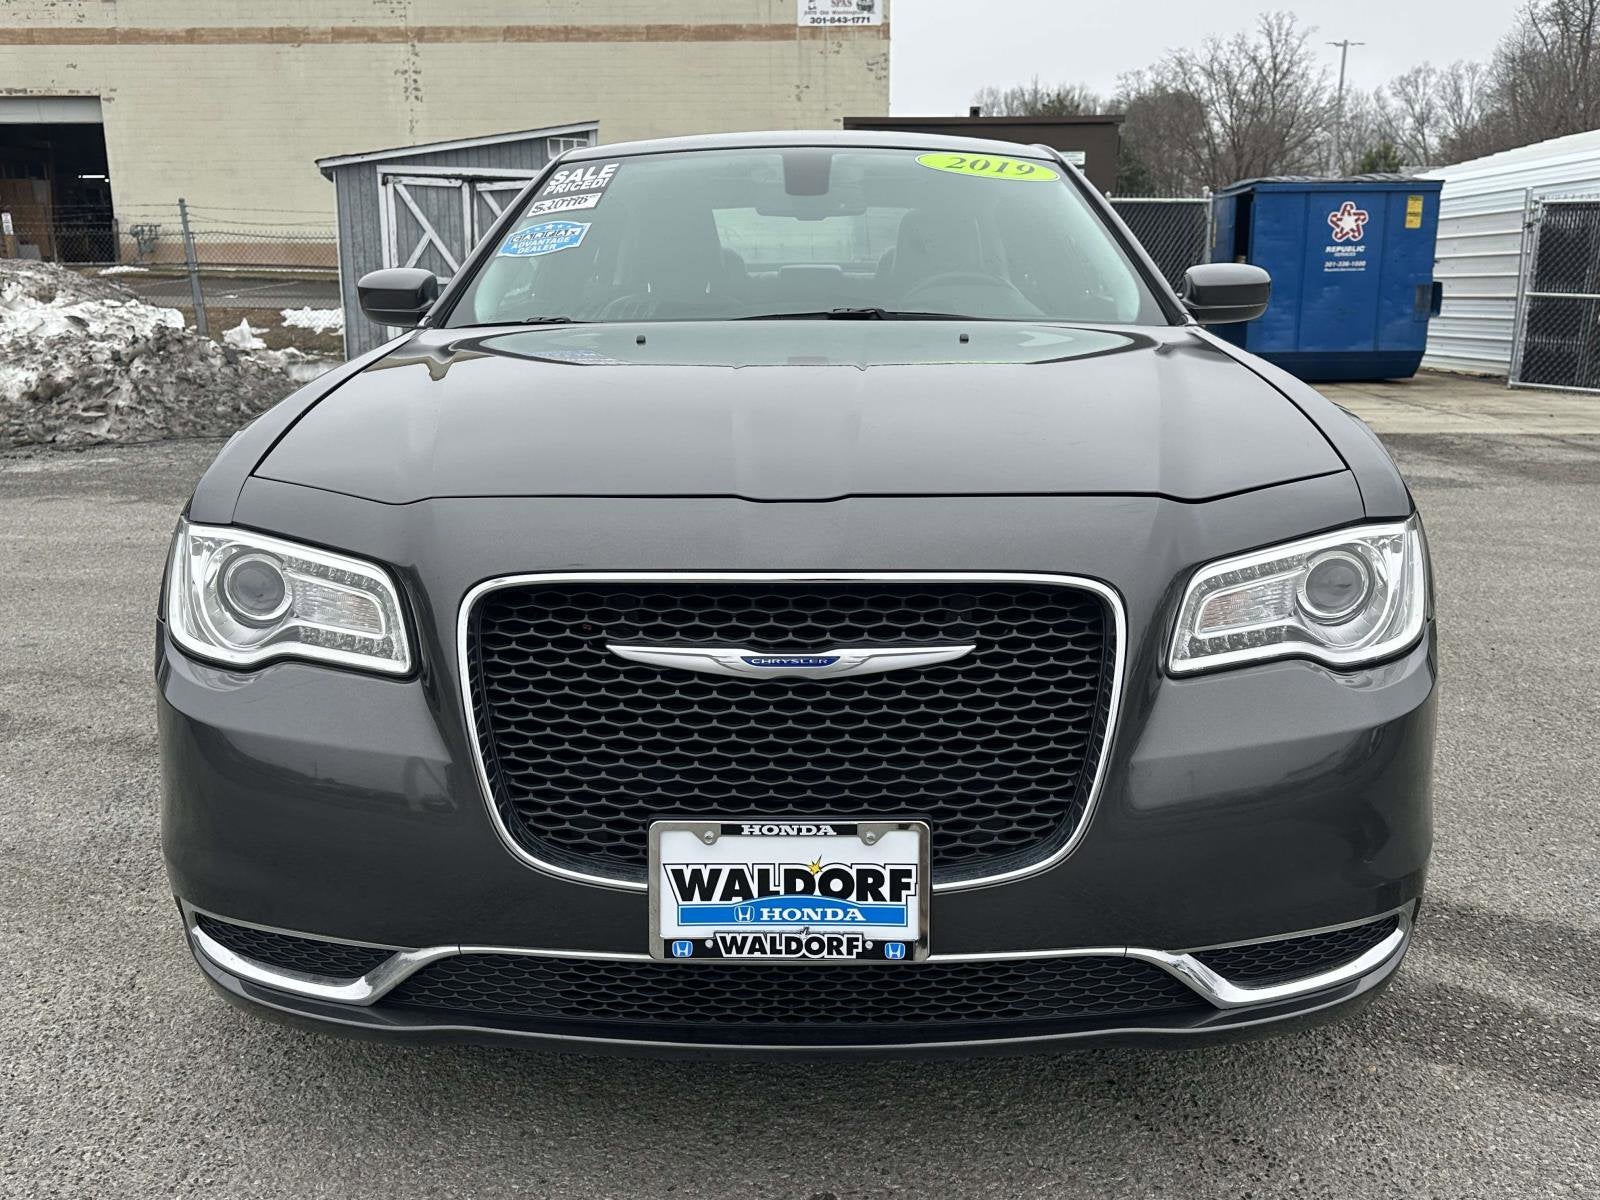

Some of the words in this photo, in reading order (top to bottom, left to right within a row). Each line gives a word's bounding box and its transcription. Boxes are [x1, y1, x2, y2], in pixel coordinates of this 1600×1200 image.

[809, 16, 870, 24] 301-843-1771
[946, 157, 1035, 175] 2019
[550, 163, 619, 186] SALE
[543, 178, 610, 196] PRICED!
[517, 244, 558, 254] DEALER
[1325, 245, 1365, 253] REPUBLIC
[741, 825, 837, 836] HONDA
[671, 867, 913, 902] WALDORF
[760, 907, 866, 921] HONDA
[719, 935, 862, 957] WALDORF
